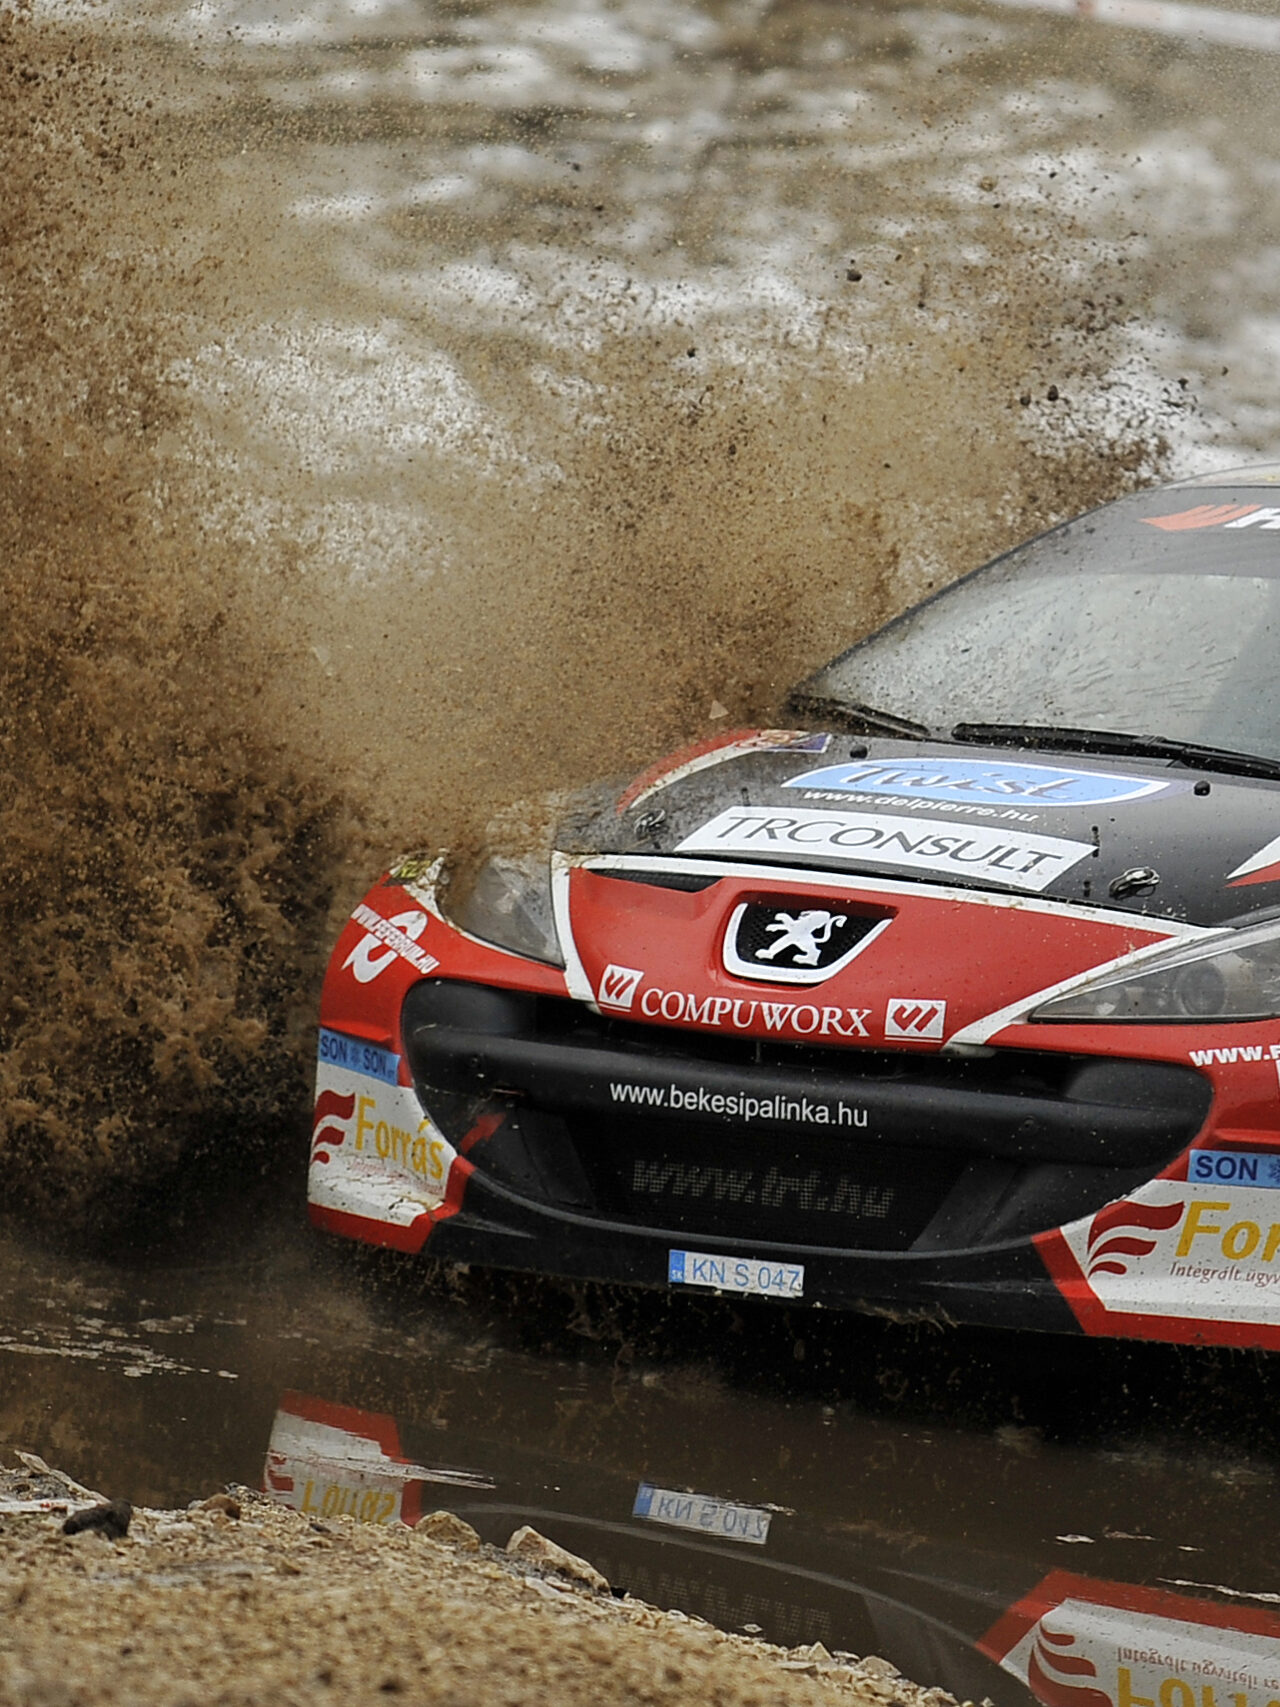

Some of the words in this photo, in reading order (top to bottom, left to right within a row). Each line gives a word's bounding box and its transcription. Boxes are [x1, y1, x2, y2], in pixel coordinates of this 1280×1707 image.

[840, 763, 1083, 801] Twist
[716, 814, 1063, 872] TRCONSULT
[641, 988, 871, 1038] COMPUWORX
[320, 1035, 348, 1063] SON
[363, 1048, 386, 1075] SON
[610, 1084, 868, 1128] www.bekesipalinka.hu
[354, 1096, 444, 1180] Forrás
[1195, 1156, 1259, 1181] SON
[693, 1258, 725, 1284] KN
[734, 1263, 749, 1287] S
[757, 1266, 800, 1292] 047
[1169, 1261, 1241, 1283] Integrált
